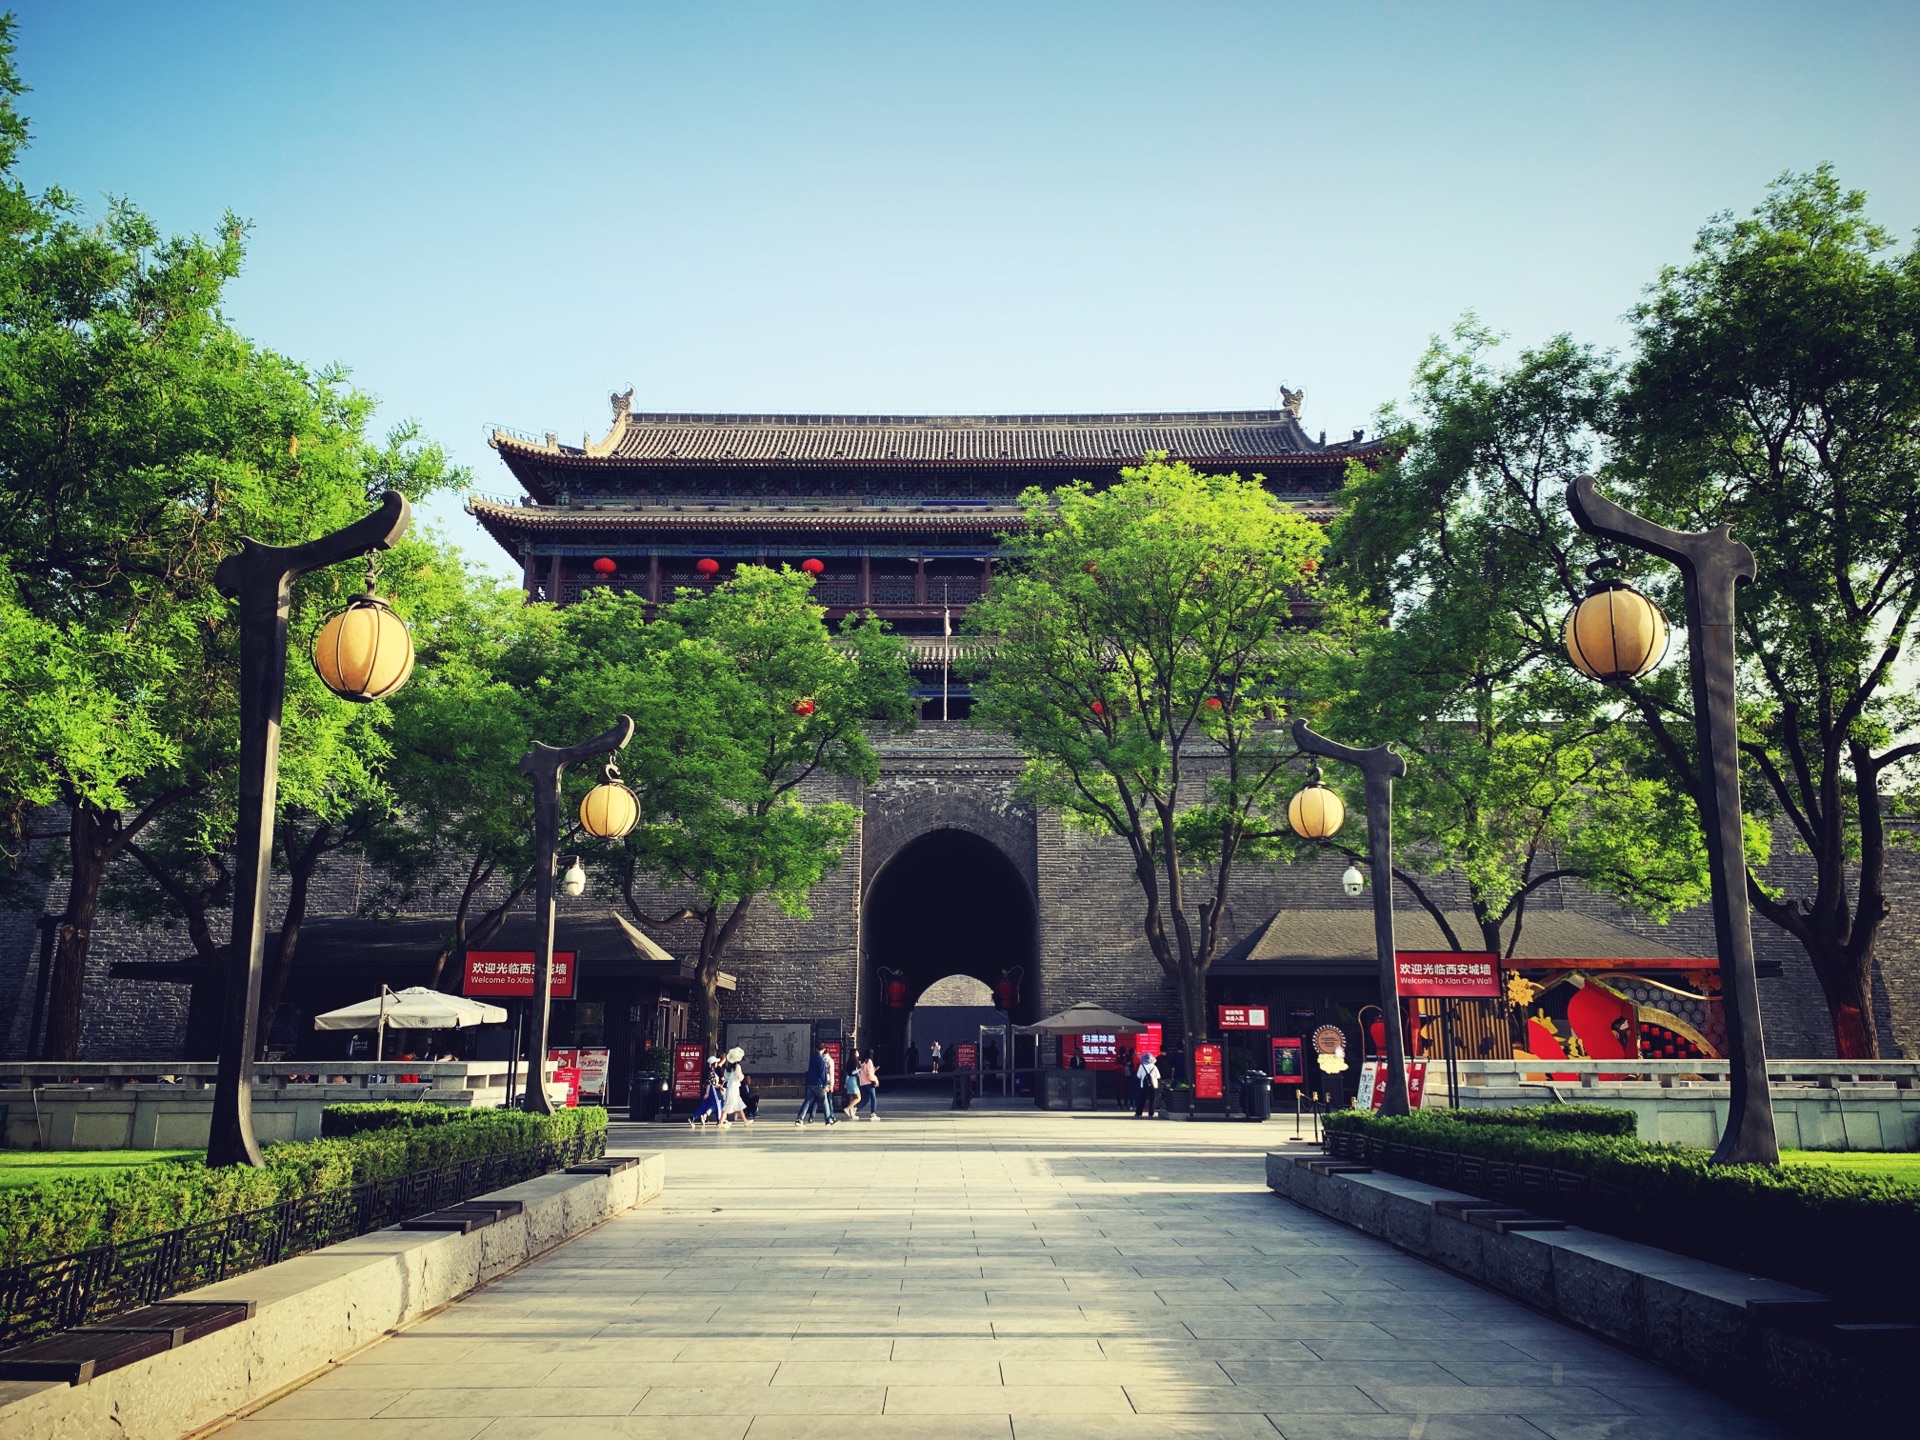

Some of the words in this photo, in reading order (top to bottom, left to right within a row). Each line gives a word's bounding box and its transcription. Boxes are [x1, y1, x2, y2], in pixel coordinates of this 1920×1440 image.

[1400, 963, 1491, 975] 欢迎光临西安城墙
[471, 976, 505, 984] Welcome
[507, 976, 515, 984] To
[1400, 977, 1433, 985] Welcome
[1435, 977, 1443, 985] To
[1444, 977, 1460, 985] Xian
[1462, 977, 1475, 986] City
[1477, 977, 1492, 985] Wall
[1082, 1034, 1115, 1043] 扫黑除恶
[1082, 1046, 1116, 1055] 弘扬正气
